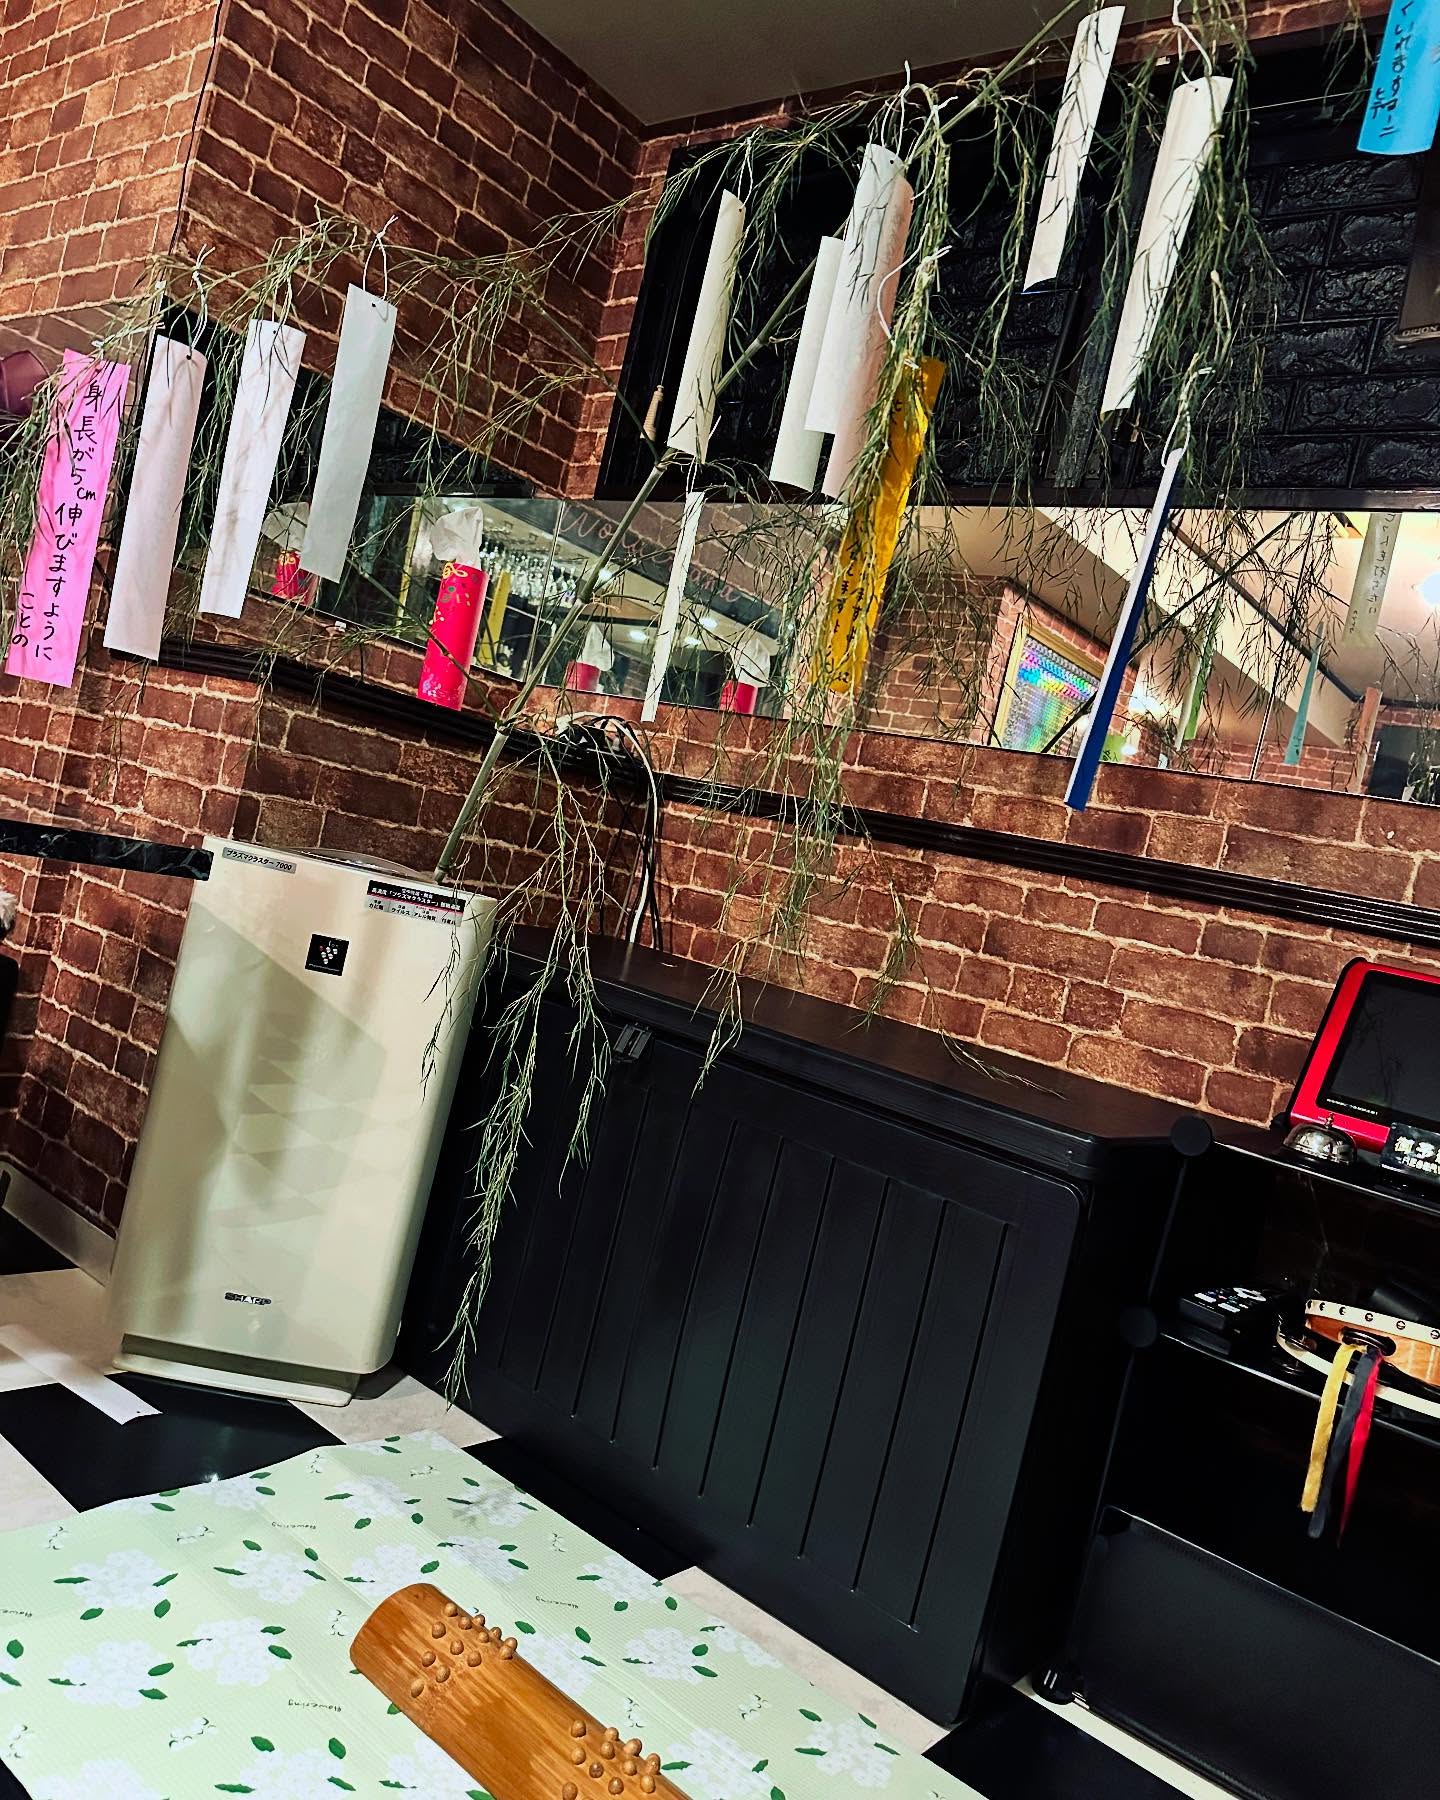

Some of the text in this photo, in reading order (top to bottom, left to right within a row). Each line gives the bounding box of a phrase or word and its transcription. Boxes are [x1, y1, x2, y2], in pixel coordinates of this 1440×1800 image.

[226, 850, 293, 872] プラズマクラスター 7000
